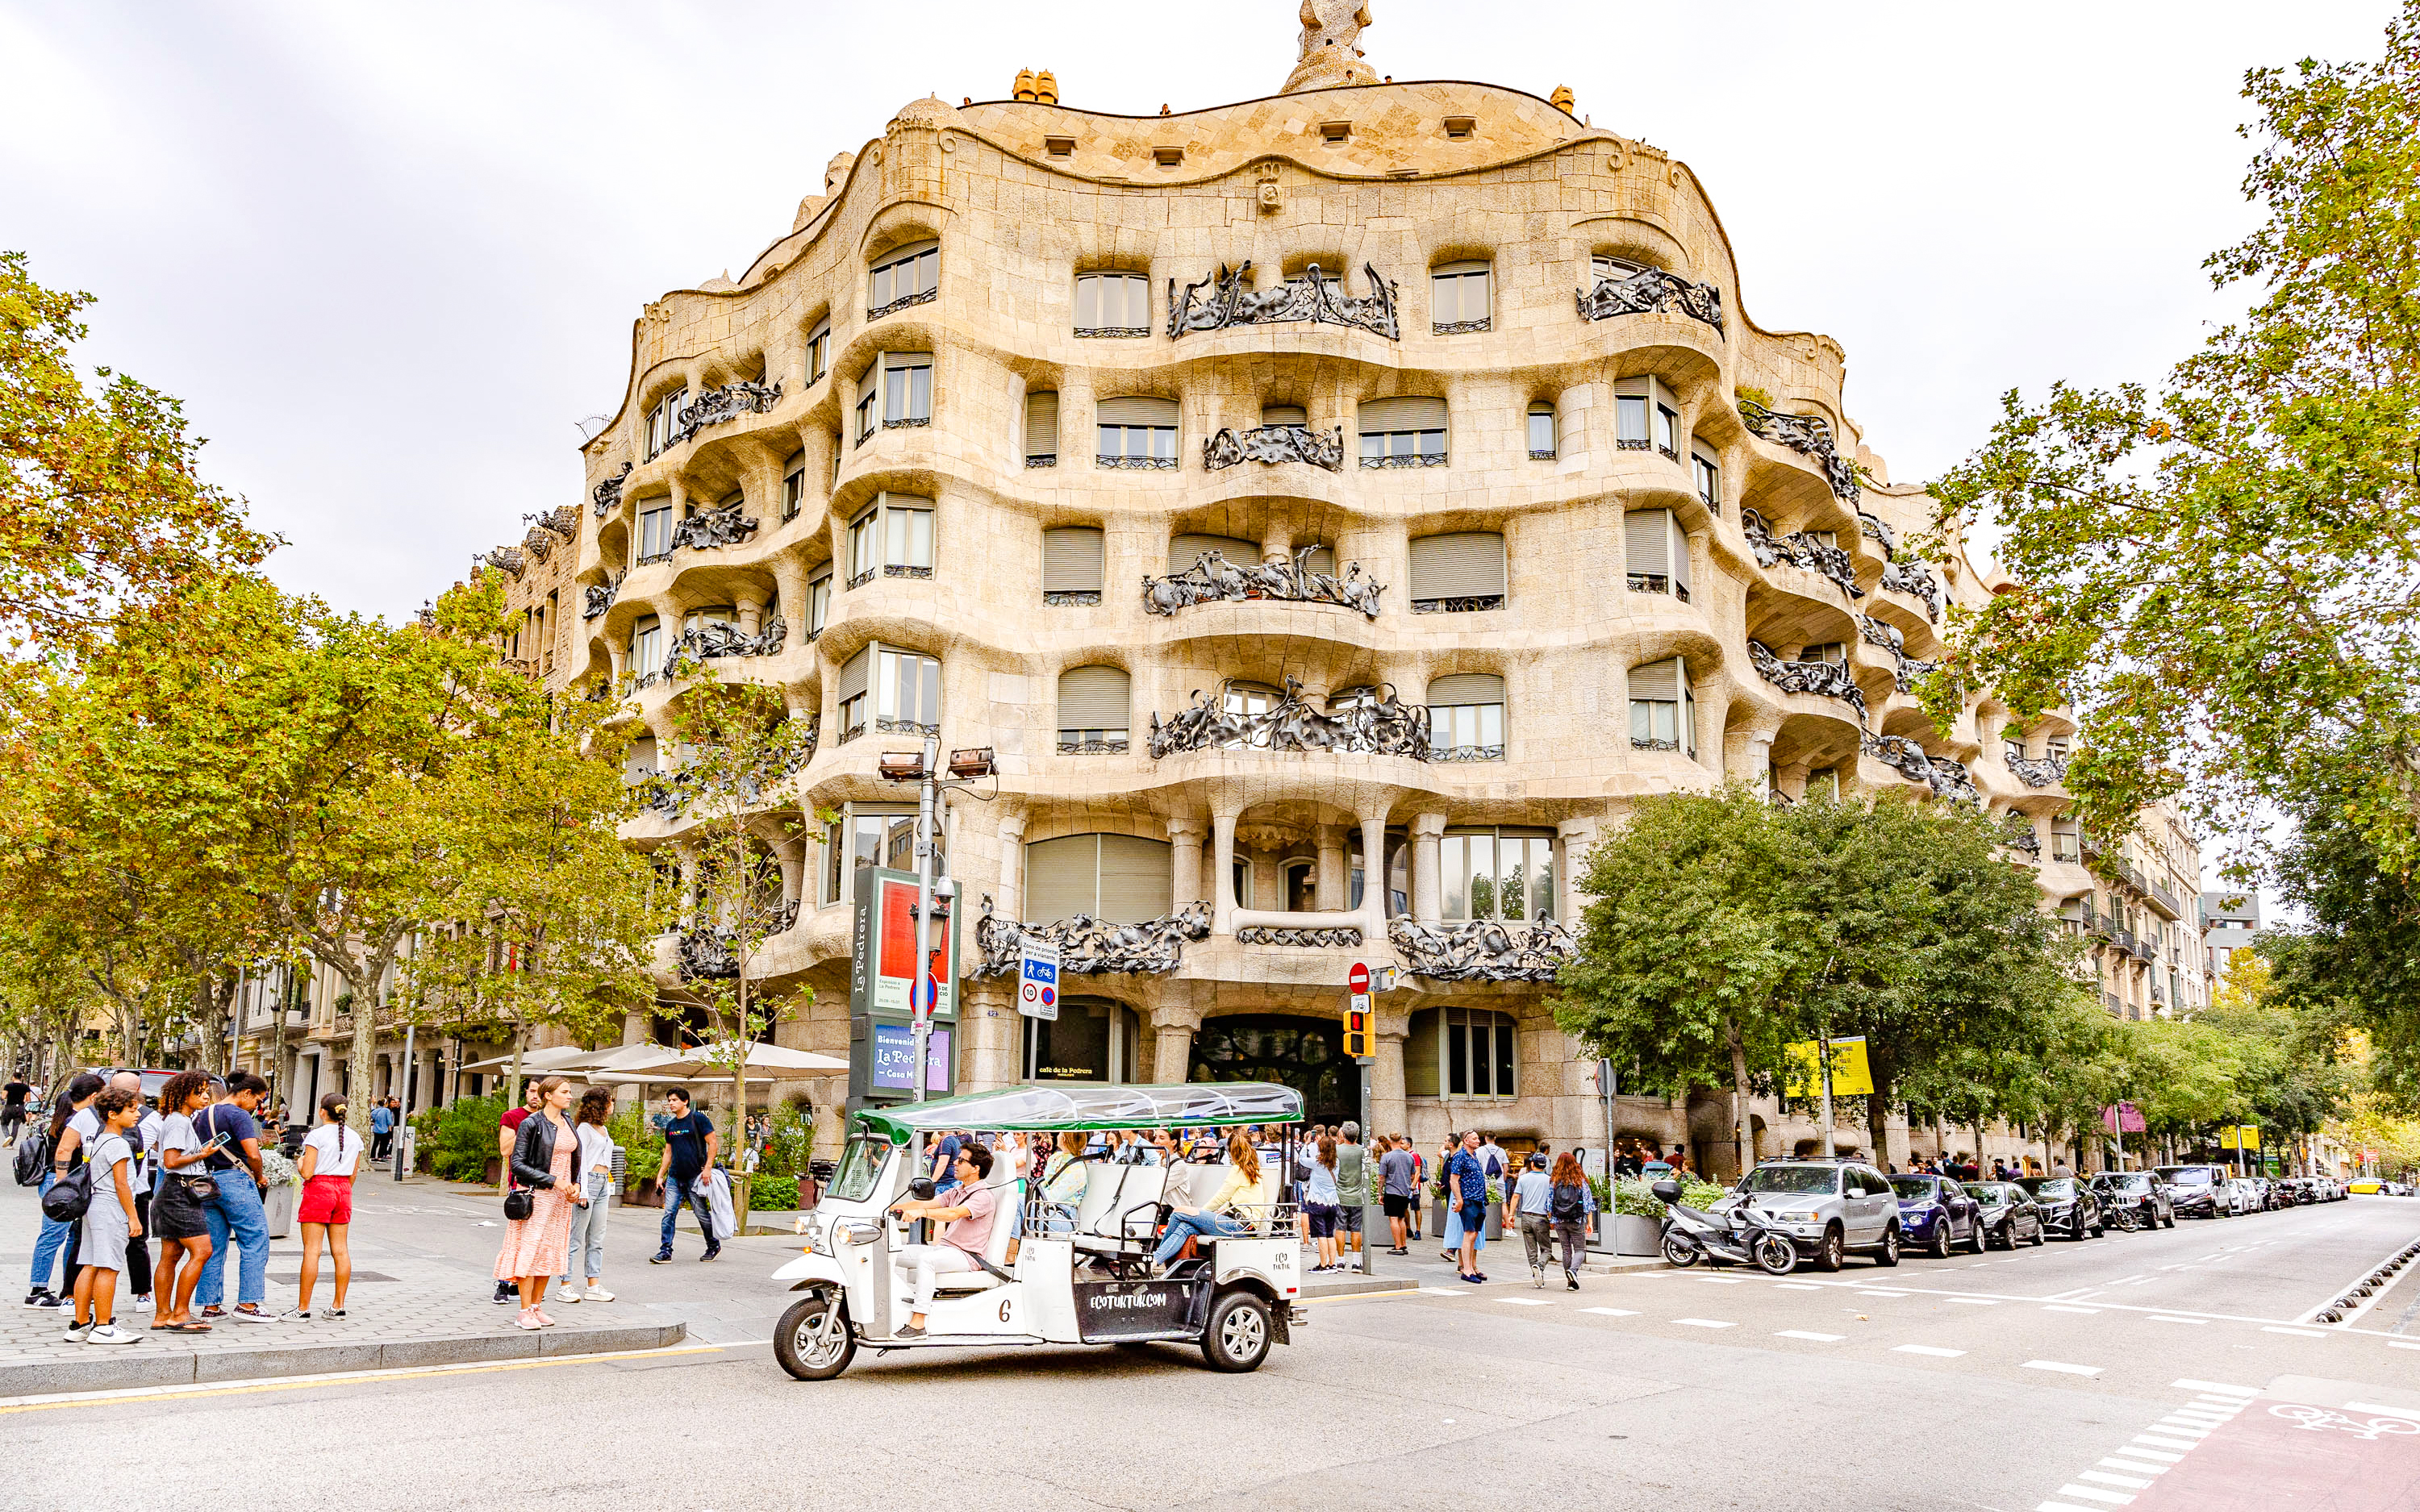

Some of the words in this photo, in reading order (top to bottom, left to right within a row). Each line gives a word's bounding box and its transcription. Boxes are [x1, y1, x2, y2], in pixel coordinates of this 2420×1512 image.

[856, 906, 866, 974] Pedrera
[855, 975, 866, 993] La
[878, 1035, 915, 1047] Bienvenid
[877, 1049, 891, 1066] La
[892, 1050, 941, 1067] Pedra
[887, 1069, 905, 1078] Casa
[1275, 1252, 1287, 1264] ECO
[999, 1299, 1011, 1322] 6
